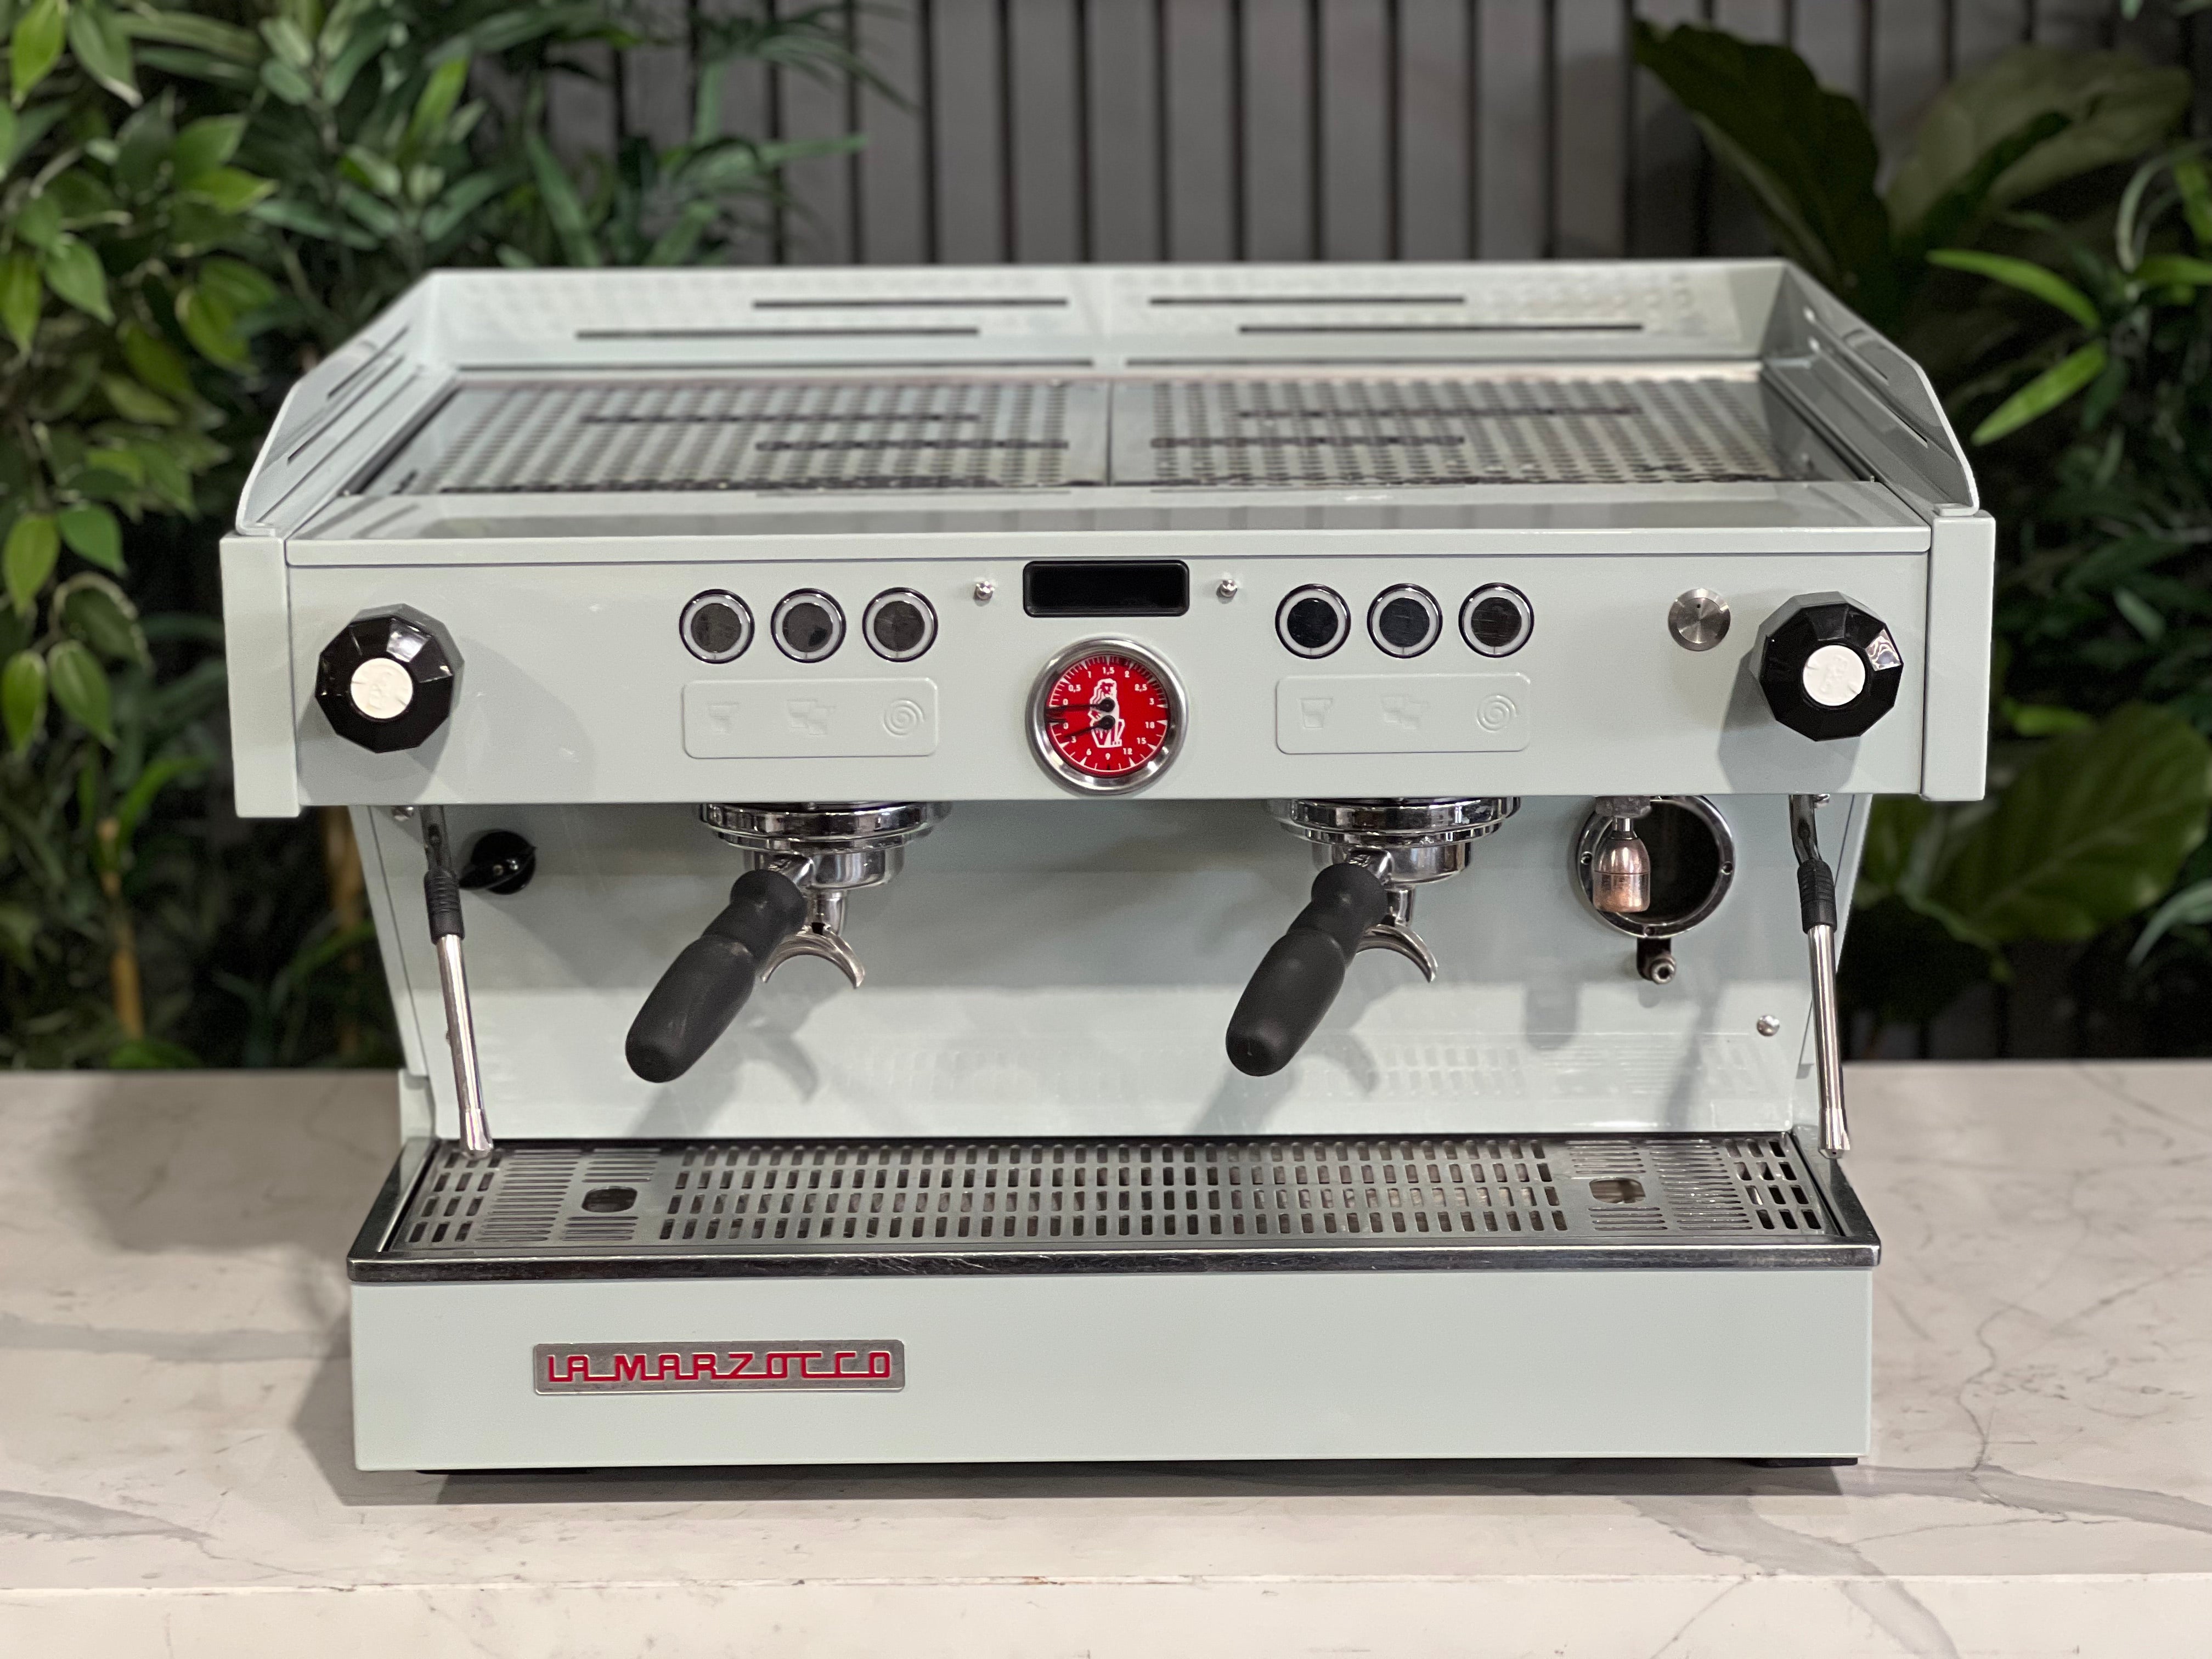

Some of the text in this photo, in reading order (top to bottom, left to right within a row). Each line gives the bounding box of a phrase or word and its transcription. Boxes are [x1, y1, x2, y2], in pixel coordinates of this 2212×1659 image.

[1102, 667, 1115, 675] 1,5
[1068, 684, 1081, 692] 0,5
[1134, 684, 1148, 692] 2,5
[548, 1351, 890, 1382] LA MARZOCCO
